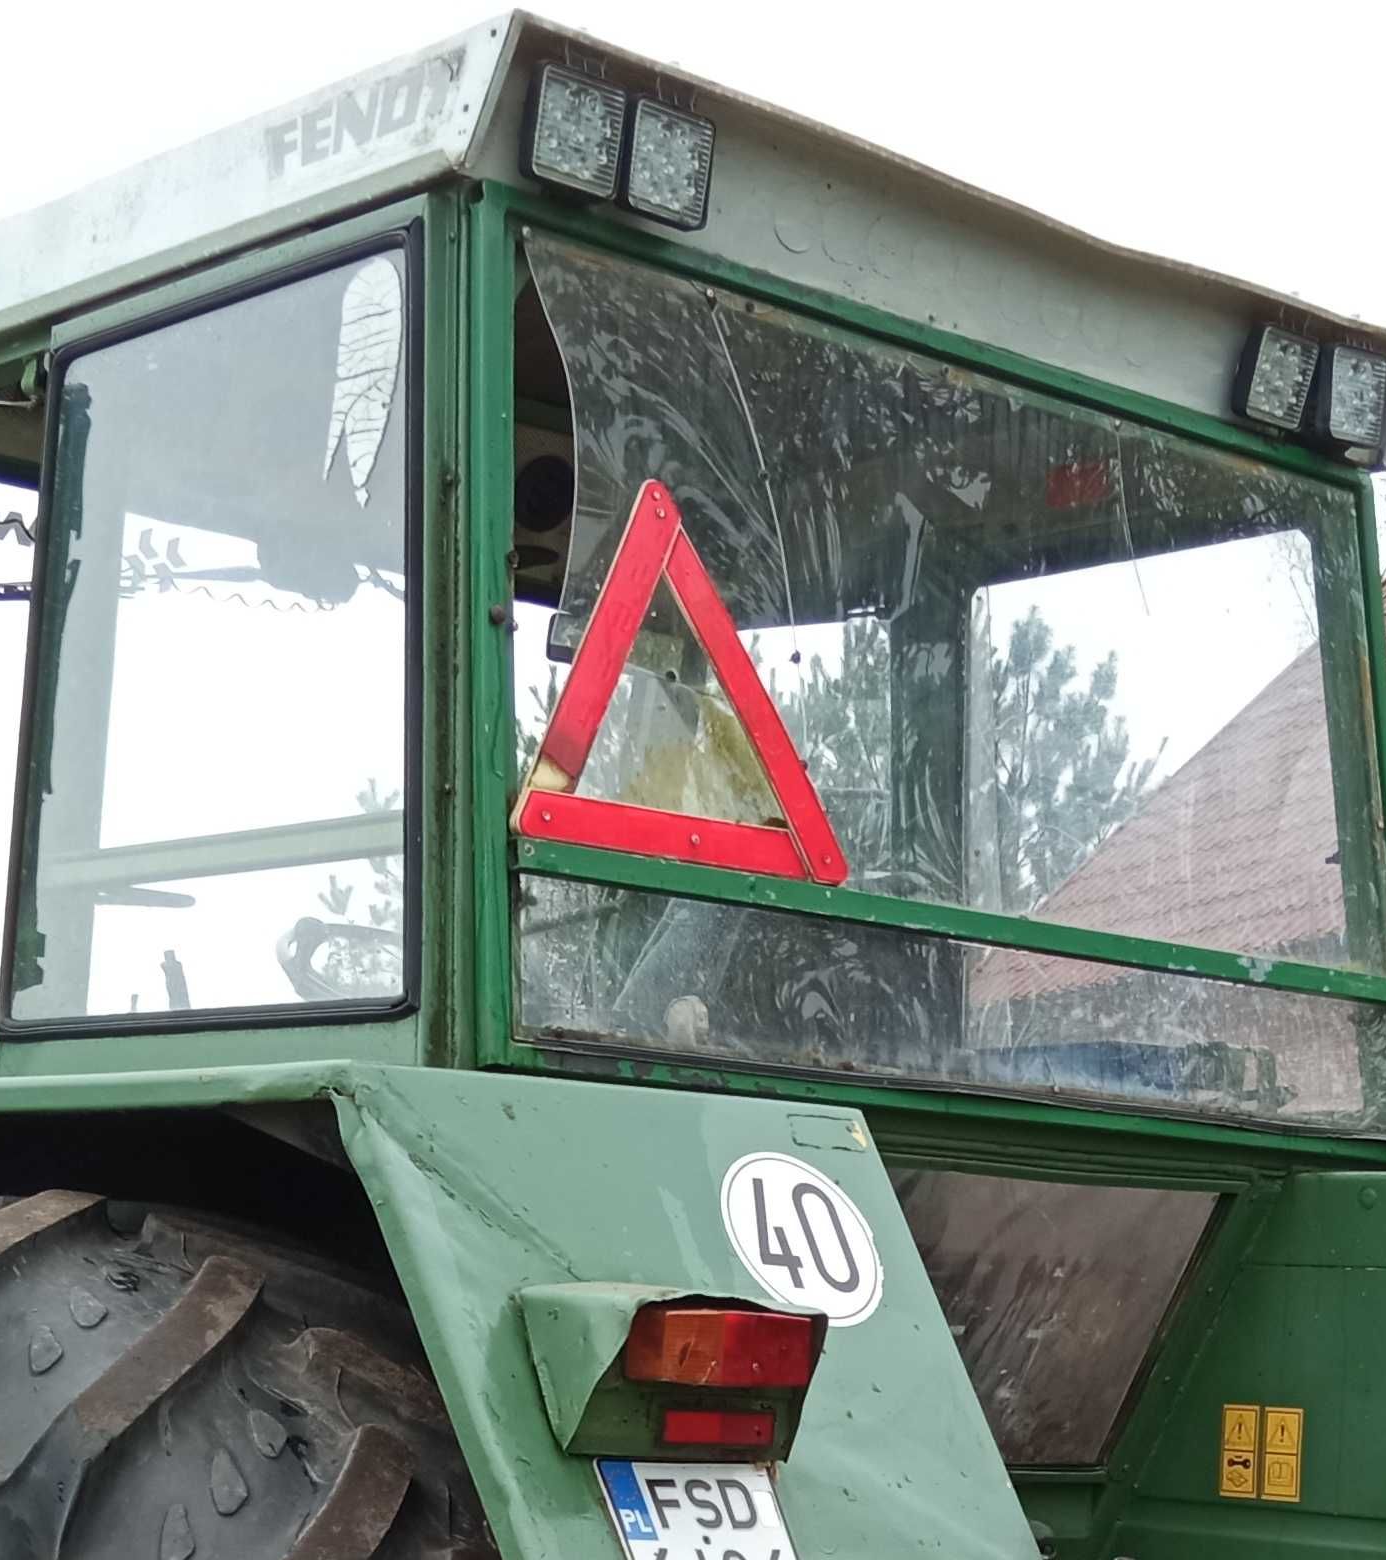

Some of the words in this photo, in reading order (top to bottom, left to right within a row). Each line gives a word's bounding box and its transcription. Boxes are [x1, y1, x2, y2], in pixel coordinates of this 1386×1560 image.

[751, 1177, 861, 1293] 40
[622, 1507, 654, 1534] PL
[646, 1478, 758, 1531] FSD
